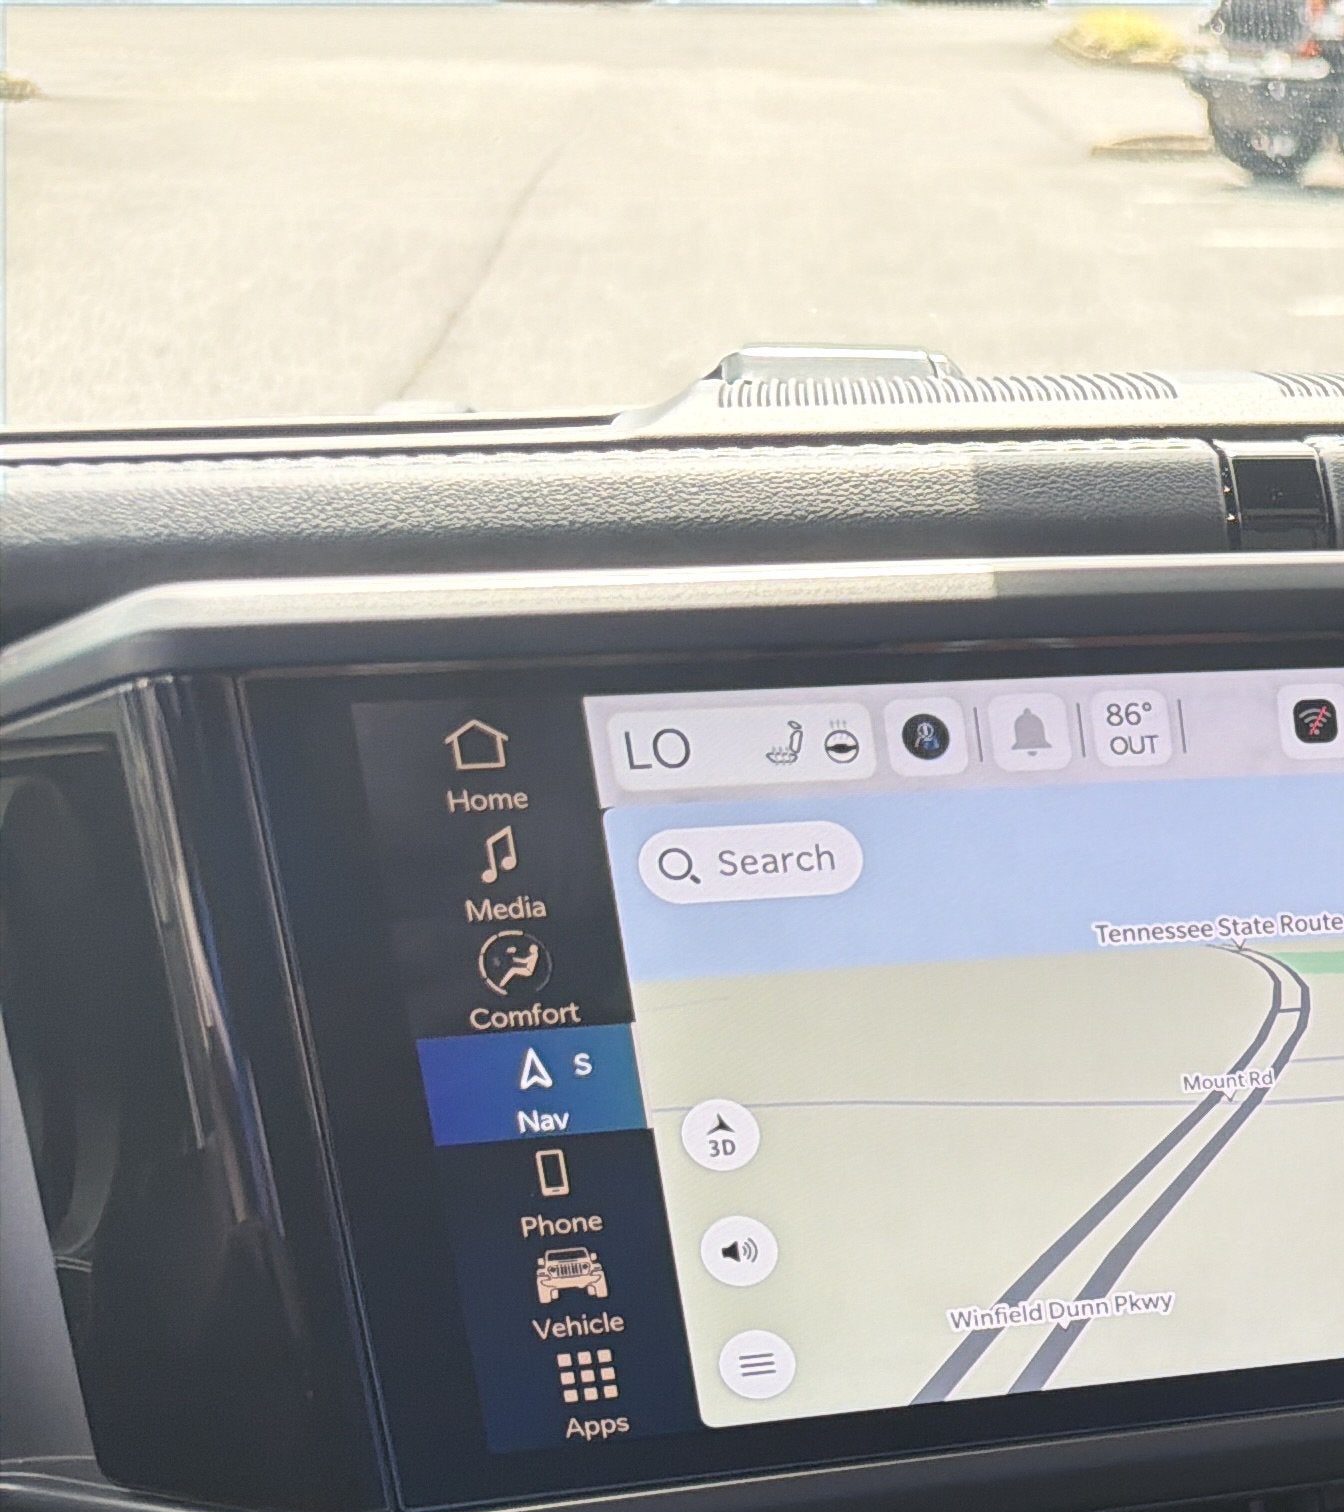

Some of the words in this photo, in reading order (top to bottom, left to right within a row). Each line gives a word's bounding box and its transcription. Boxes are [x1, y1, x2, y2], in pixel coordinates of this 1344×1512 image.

[1106, 702, 1152, 727] 86°
[624, 728, 691, 770] LO
[1109, 734, 1159, 756] OUT
[446, 789, 529, 813] Home
[717, 844, 836, 878] Search
[465, 895, 547, 922] Media
[1096, 919, 1214, 945] Tennessee
[1218, 915, 1276, 939] State
[1280, 912, 1344, 936] Route
[469, 1001, 582, 1031] Comfort
[573, 1053, 593, 1077] S
[1183, 1073, 1244, 1092] Mount
[1248, 1070, 1273, 1088] Rd
[517, 1109, 570, 1132] Nav
[707, 1138, 737, 1158] 3D
[520, 1211, 603, 1238] Phone
[950, 1303, 1043, 1330] Winfield
[1049, 1300, 1109, 1320] Dunn
[1114, 1294, 1173, 1313] Pkwy
[531, 1312, 625, 1340] Vehicle
[565, 1412, 629, 1441] Apps
